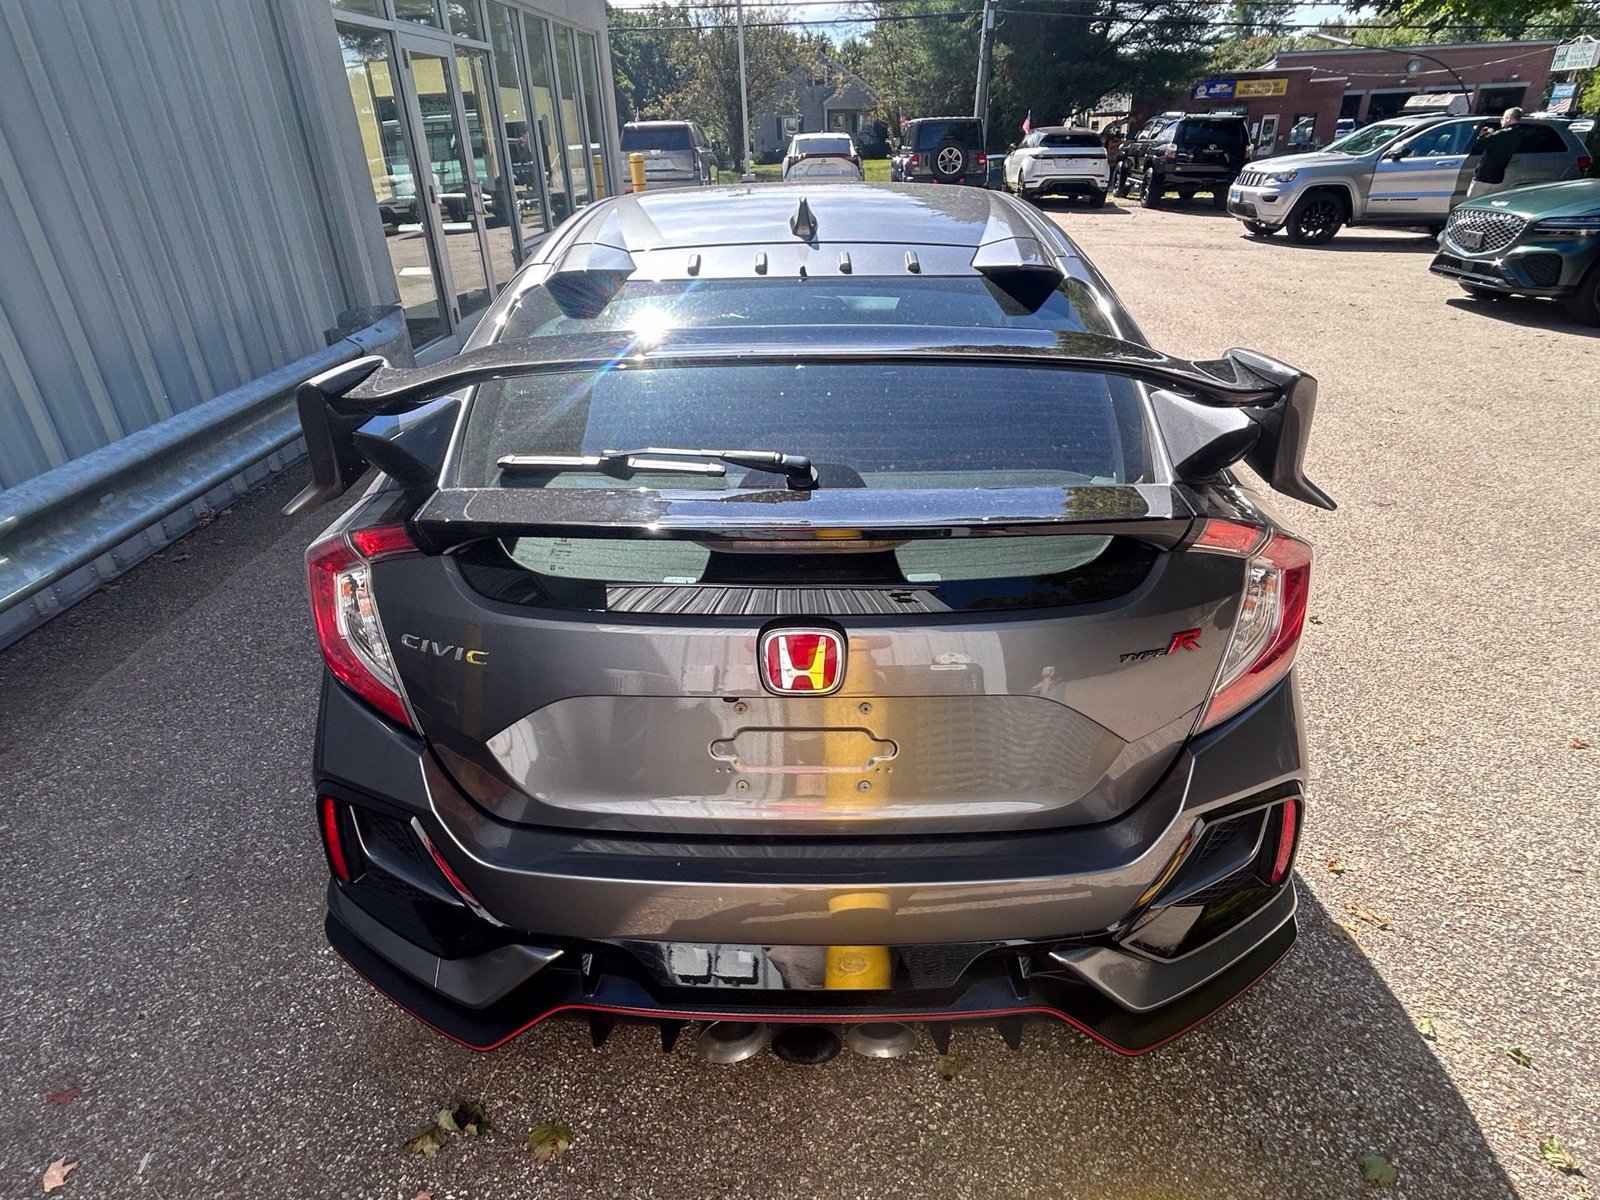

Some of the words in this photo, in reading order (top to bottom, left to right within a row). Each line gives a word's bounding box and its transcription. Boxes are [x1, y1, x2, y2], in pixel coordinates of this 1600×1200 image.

[401, 633, 490, 665] CIVIC
[1119, 647, 1168, 663] TYPE
[1167, 628, 1202, 654] R
